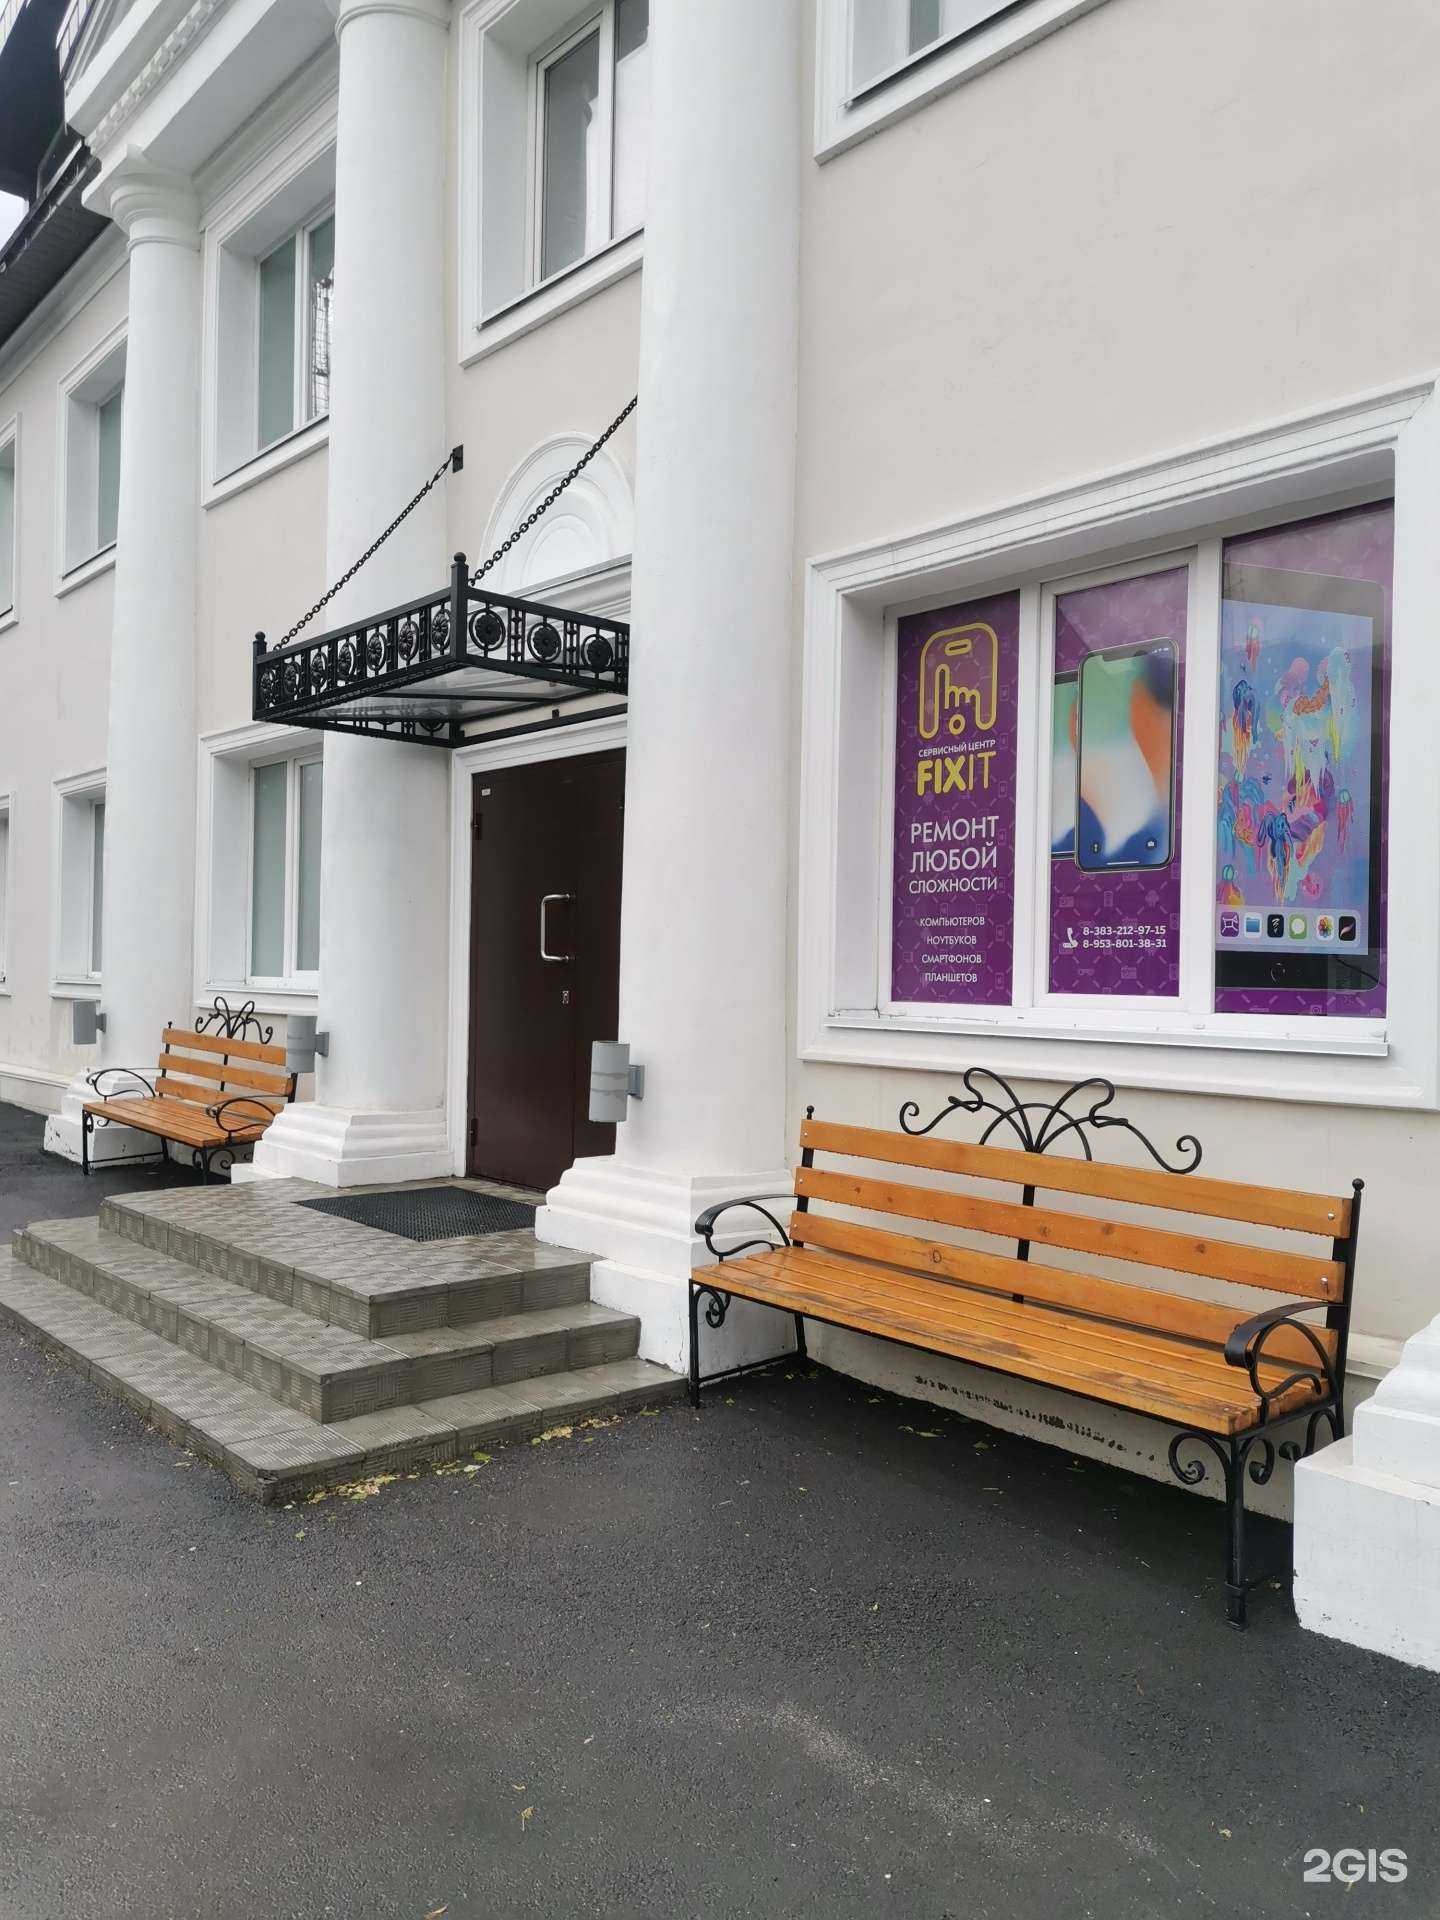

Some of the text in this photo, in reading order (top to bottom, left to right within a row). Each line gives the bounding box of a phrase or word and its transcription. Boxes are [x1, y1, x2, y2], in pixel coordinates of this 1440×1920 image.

[918, 739, 996, 758] СЕРВИСНЫЙ ЦЕНТР
[916, 750, 997, 797] FIXIT
[911, 815, 1000, 844] РЕМОНТ
[910, 841, 998, 874] ЛЮБОЙ
[909, 876, 998, 895] СЛОЖНОСТИ
[919, 916, 986, 928] КОМПЬЮТЕРОВ
[1082, 925, 1167, 936] 8-383-212-97-15
[926, 935, 977, 946] НОУТБУКОВ
[1082, 939, 1167, 949] 8-953-801-38-31
[921, 954, 982, 964] СМАРТФОНОВ
[924, 972, 978, 983] ПЛАНШЕТОВ
